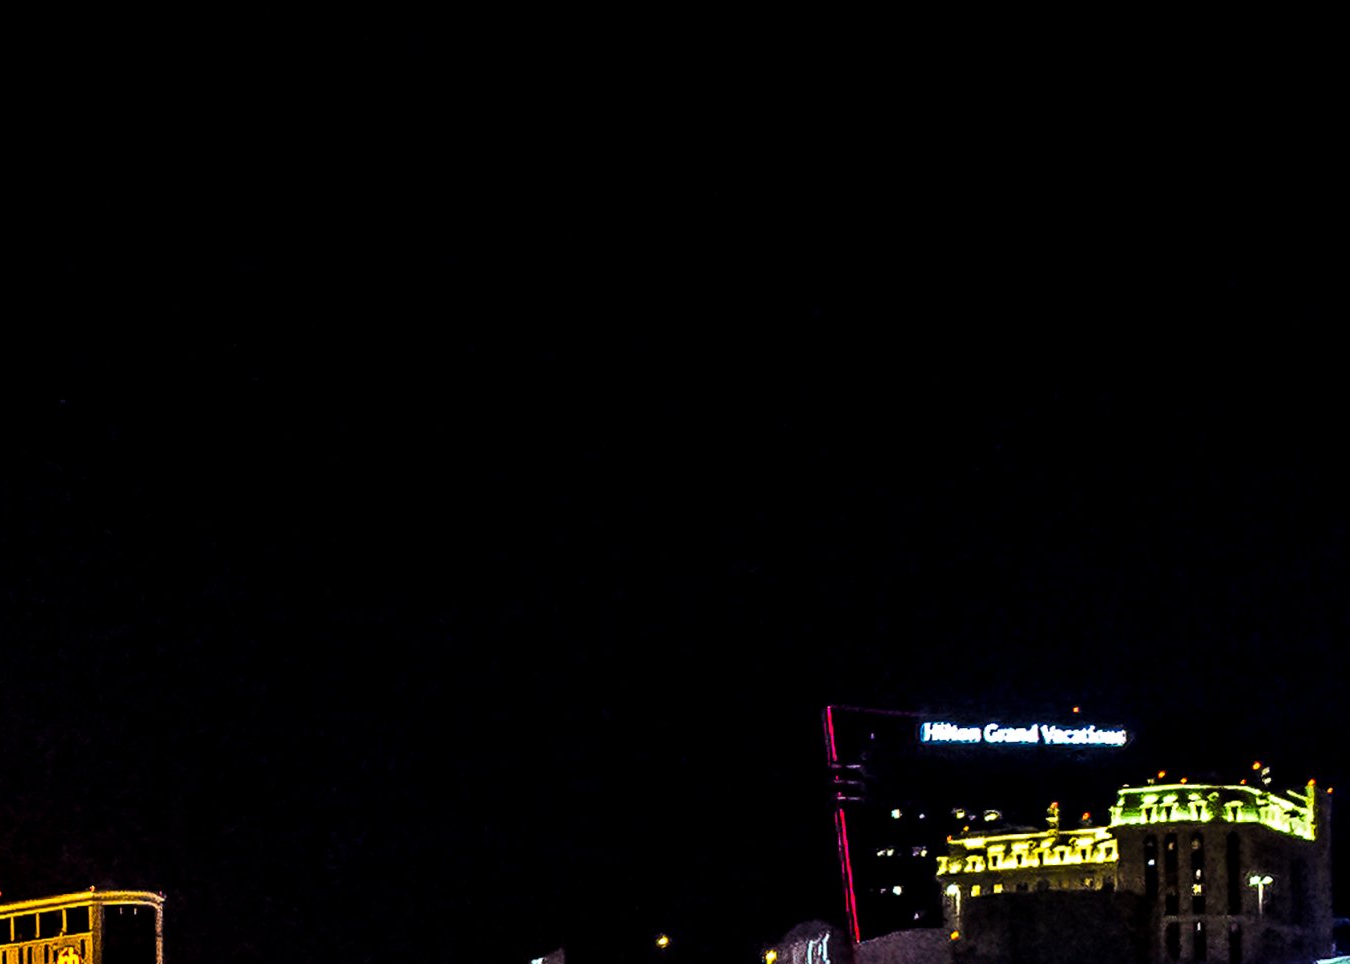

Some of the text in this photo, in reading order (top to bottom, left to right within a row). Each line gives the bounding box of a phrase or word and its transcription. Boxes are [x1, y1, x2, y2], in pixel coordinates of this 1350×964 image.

[921, 722, 1127, 747] Hilton Grand Vacations
